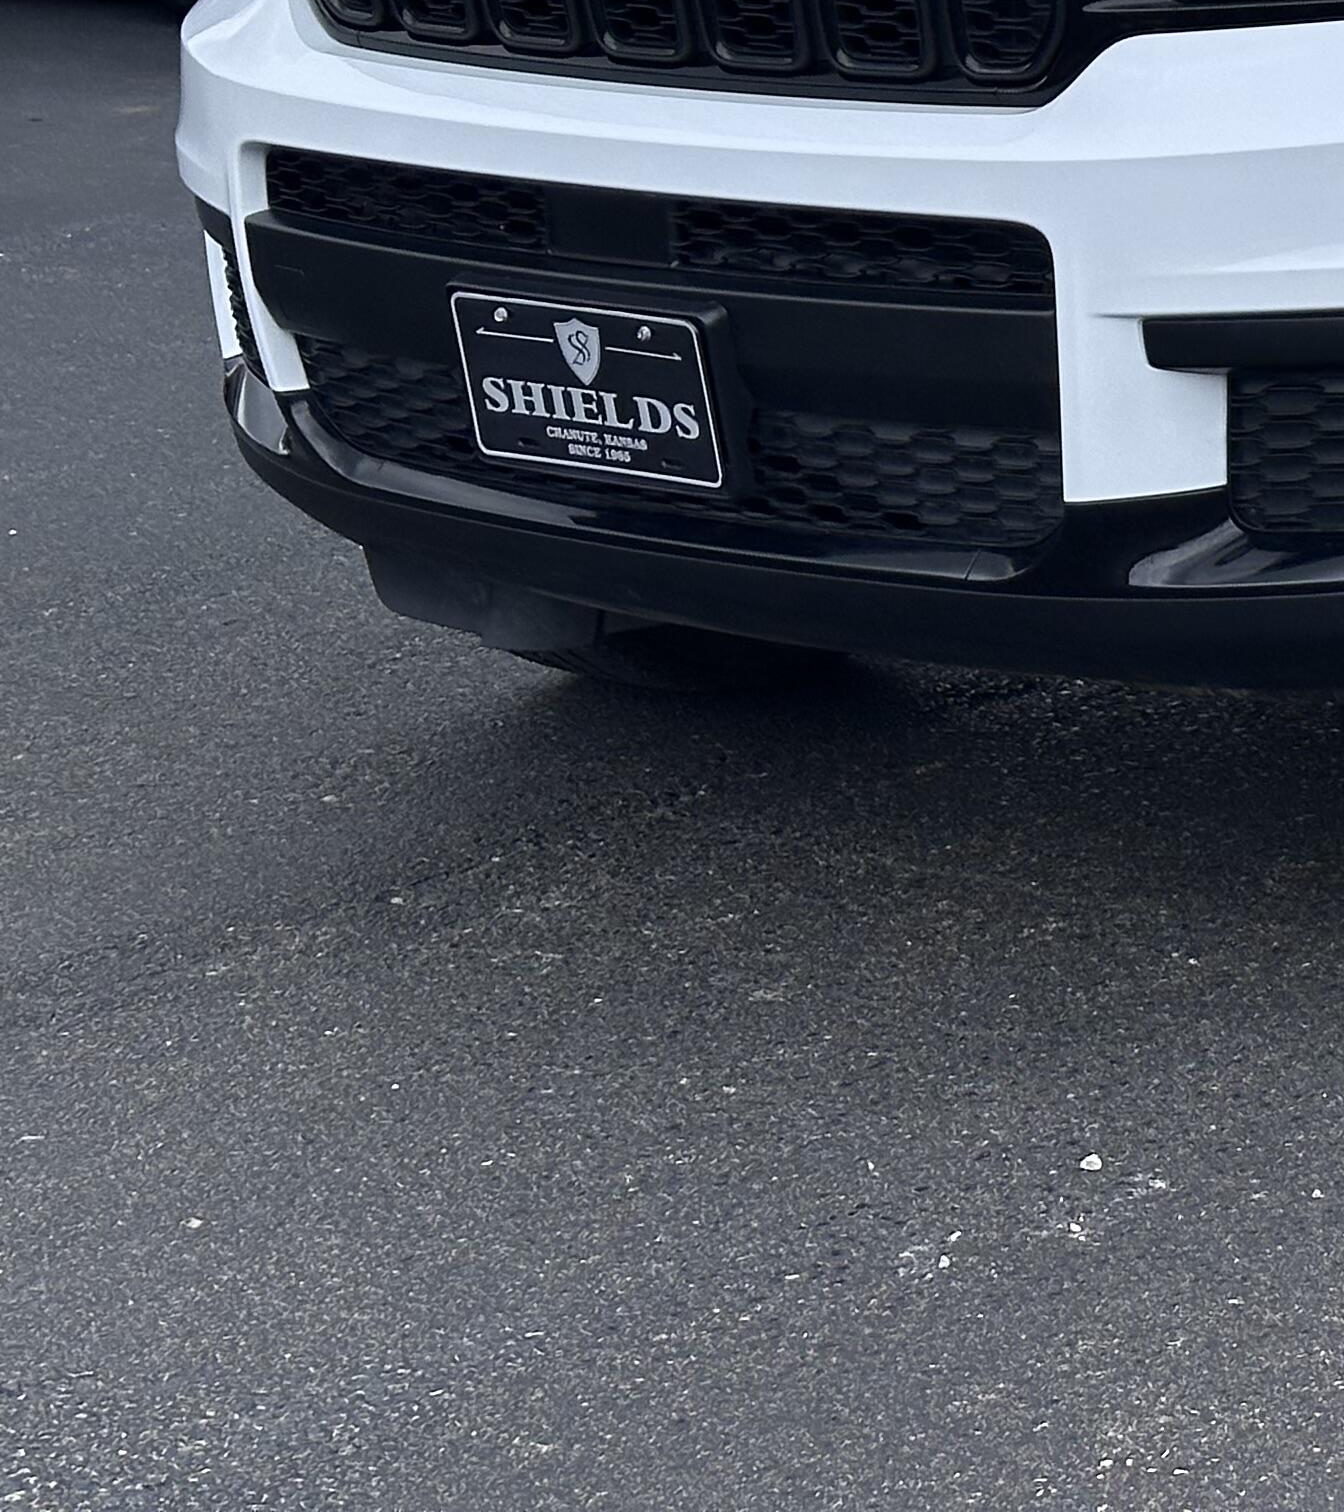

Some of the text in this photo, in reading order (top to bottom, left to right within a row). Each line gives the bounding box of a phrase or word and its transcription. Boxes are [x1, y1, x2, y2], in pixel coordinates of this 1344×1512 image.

[481, 376, 701, 440] SHIELDS
[546, 425, 648, 451] CHANUTE, KANSAS
[567, 443, 602, 459] SINCE
